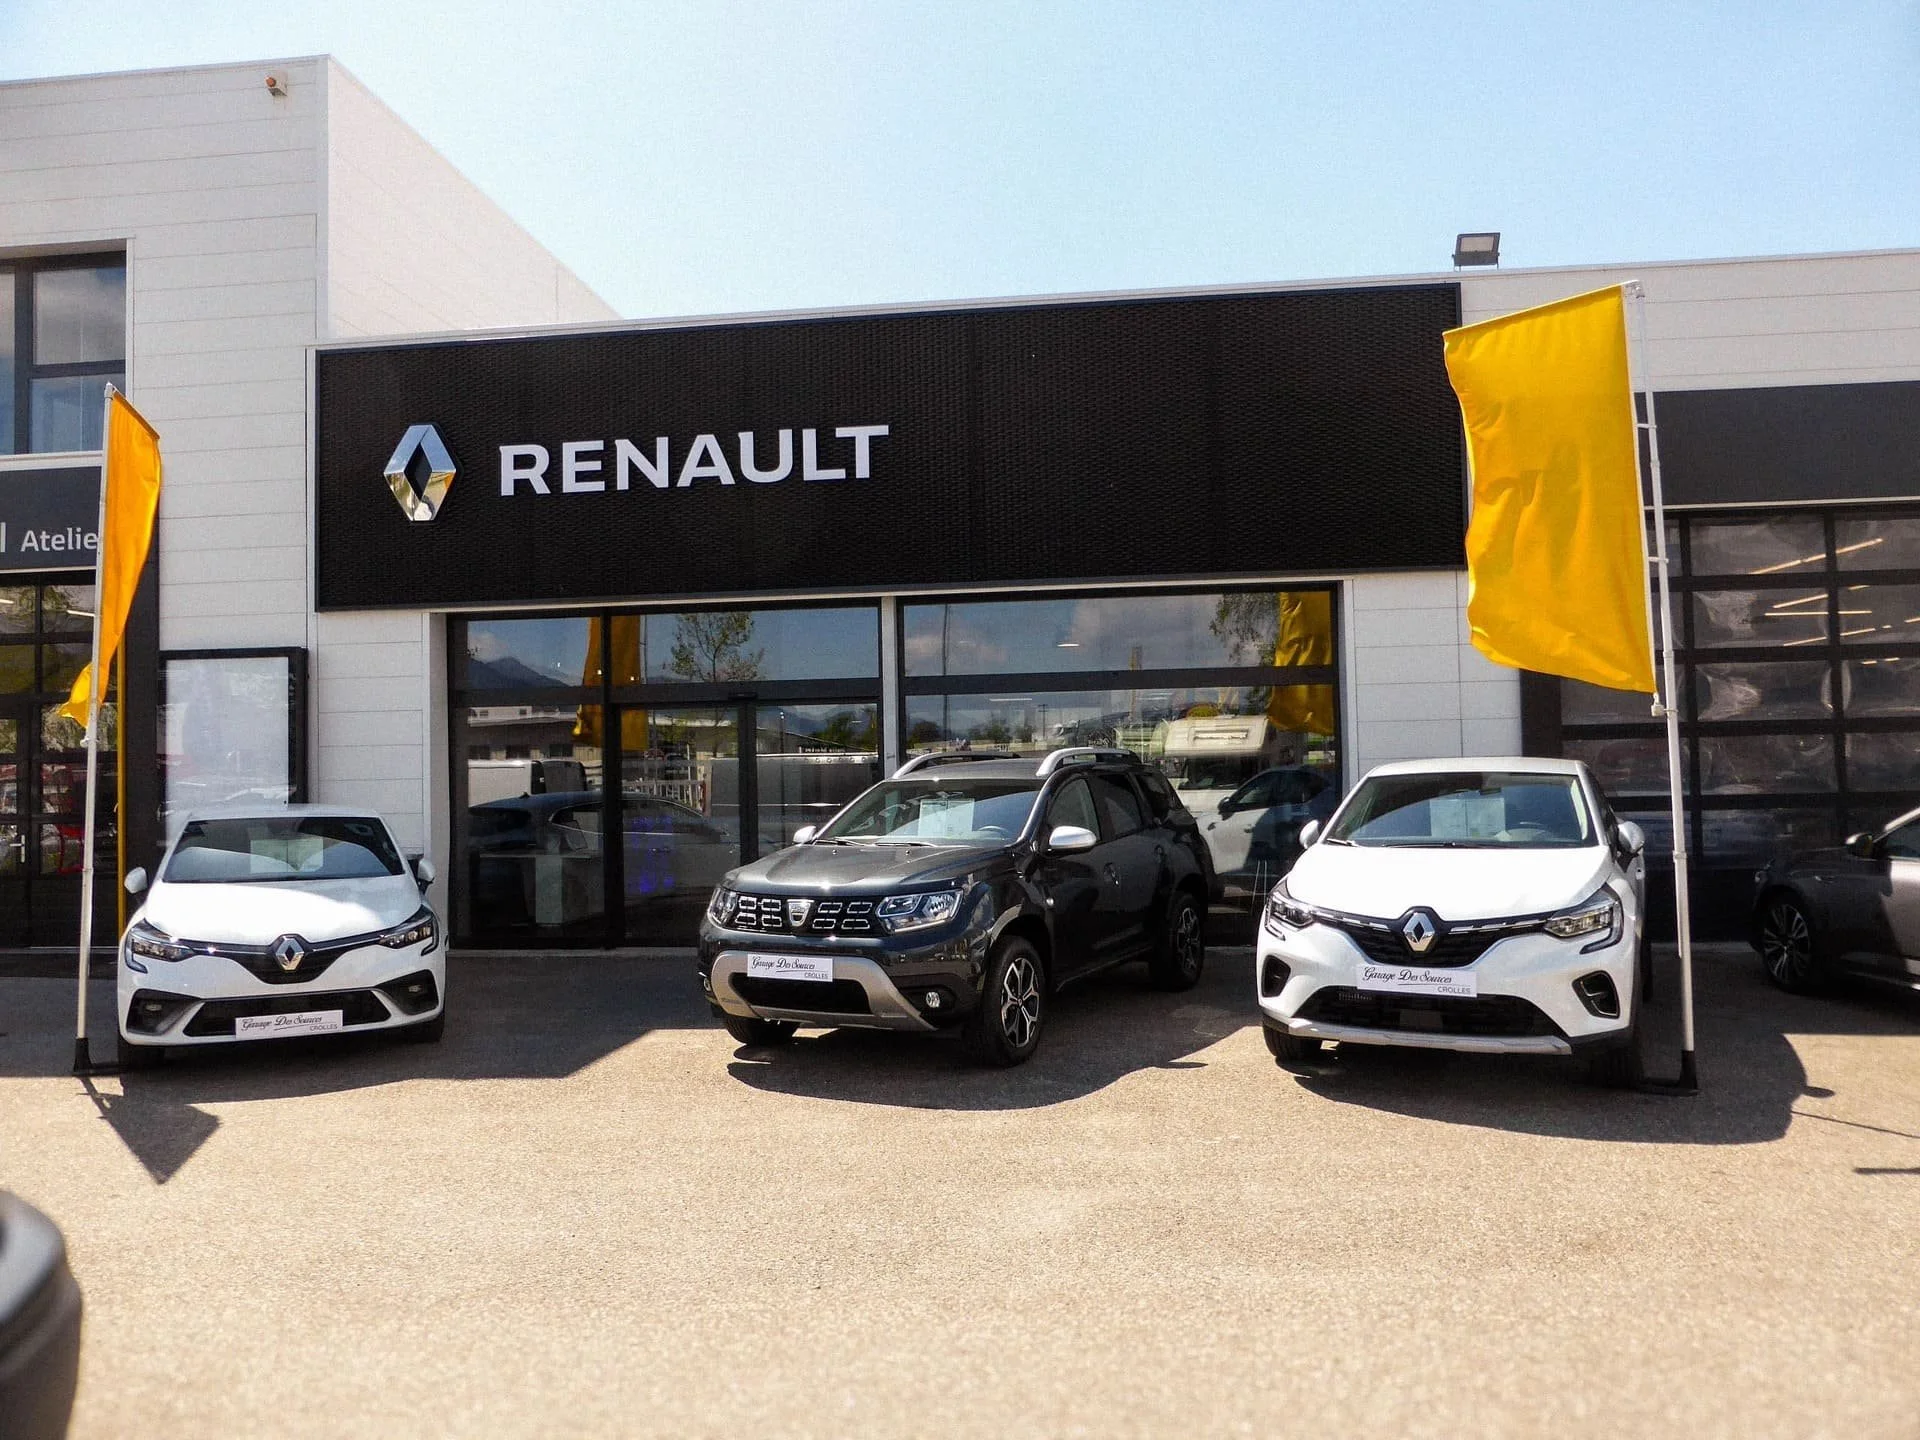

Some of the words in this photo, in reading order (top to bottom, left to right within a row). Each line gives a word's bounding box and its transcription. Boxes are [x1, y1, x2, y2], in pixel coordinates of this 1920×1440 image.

[499, 424, 889, 497] RENAULT
[20, 527, 98, 552] Atelie
[751, 956, 775, 970] Garage
[804, 972, 828, 980] CROLLES
[1362, 966, 1396, 983] Garage
[1398, 969, 1418, 981] Des
[1419, 970, 1452, 984] Sources
[1437, 986, 1471, 994] CROLLES
[309, 1023, 338, 1031] CROLLES
